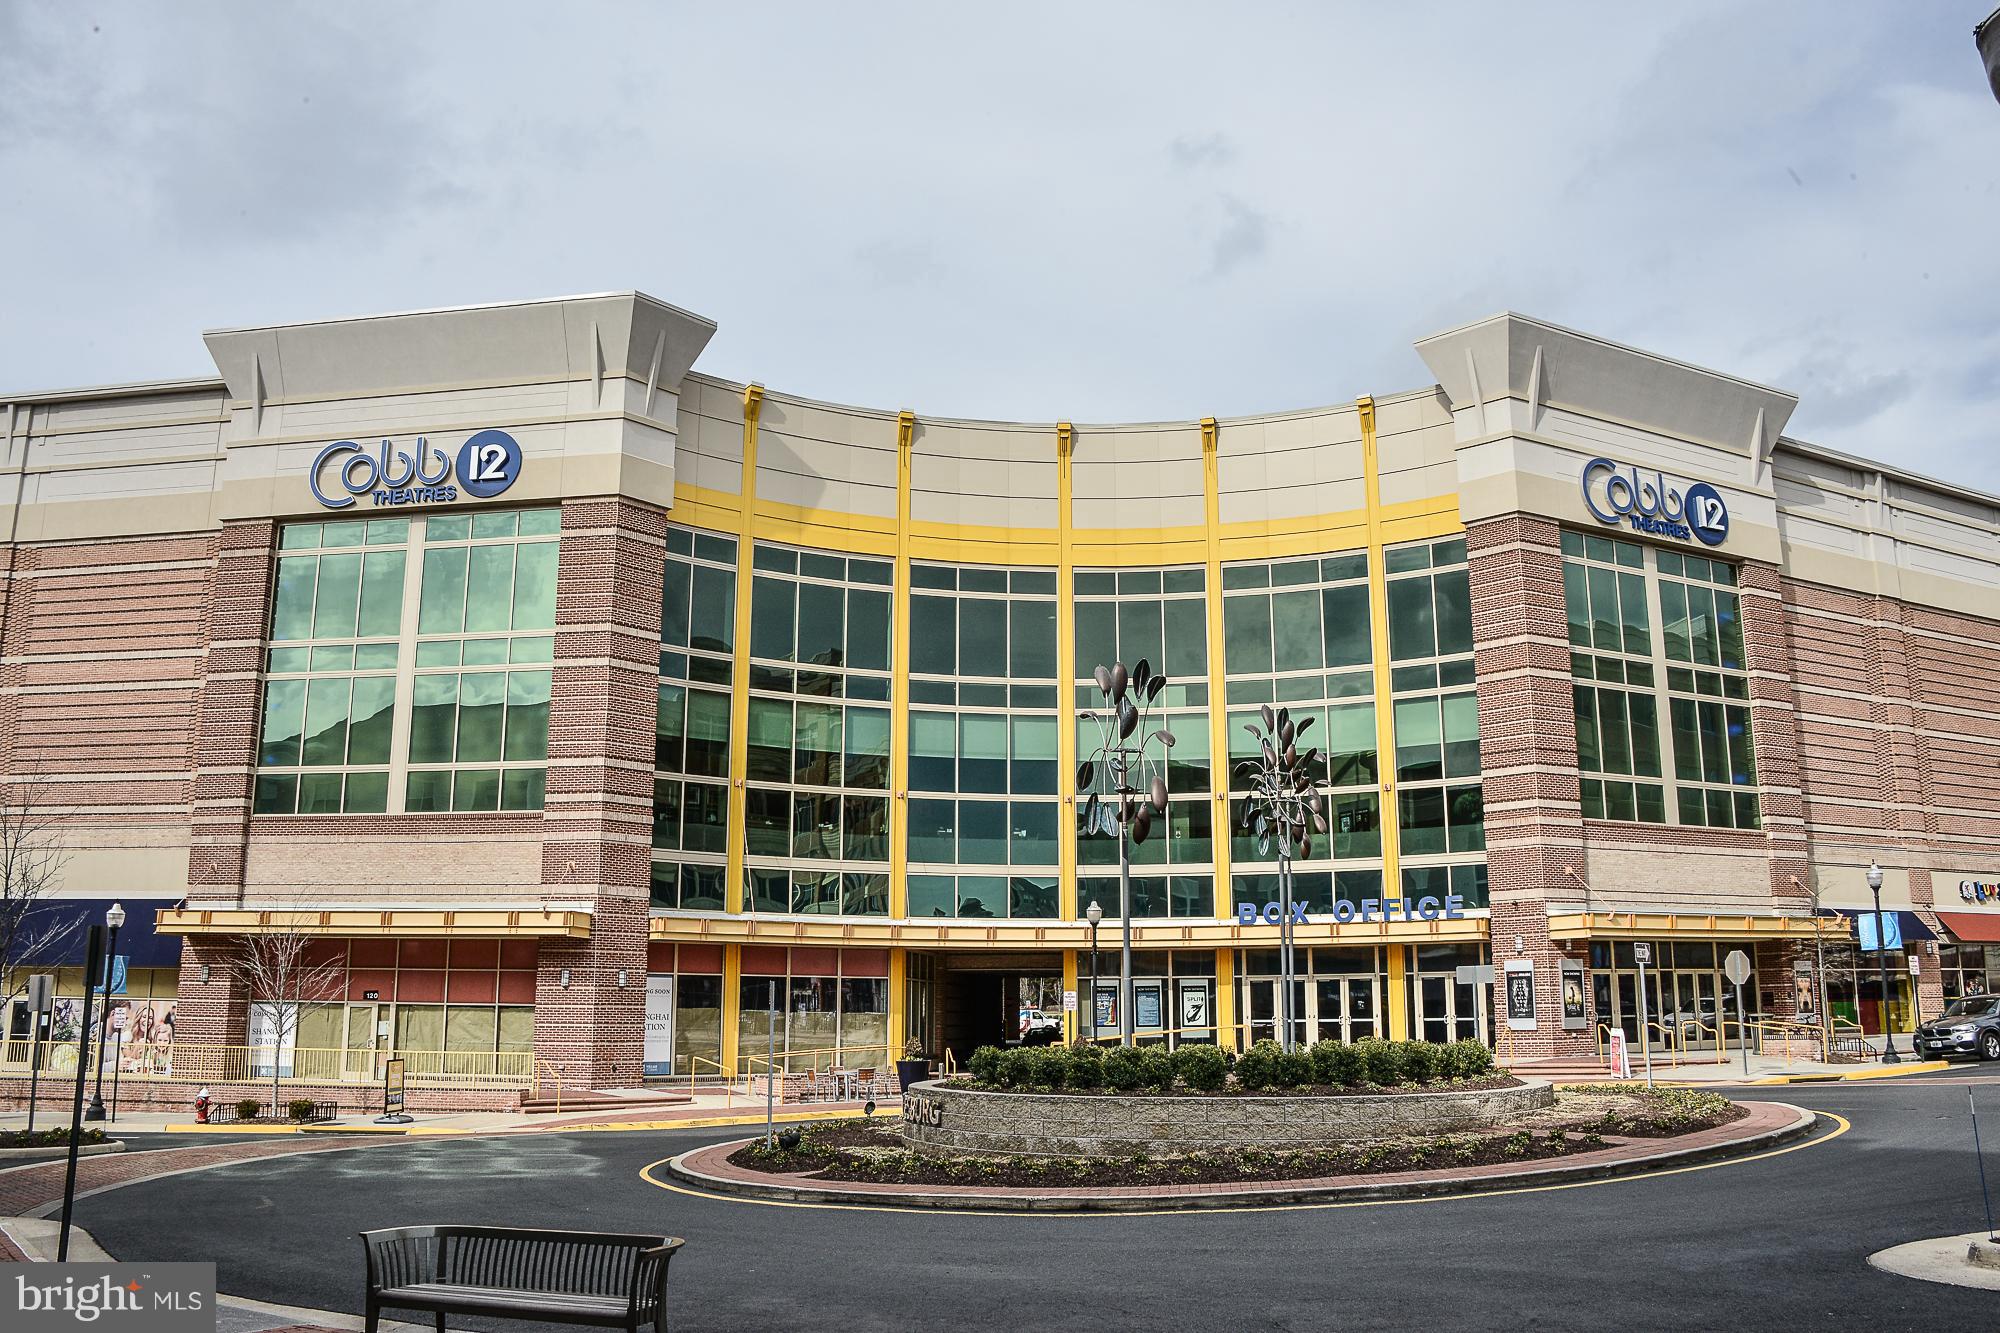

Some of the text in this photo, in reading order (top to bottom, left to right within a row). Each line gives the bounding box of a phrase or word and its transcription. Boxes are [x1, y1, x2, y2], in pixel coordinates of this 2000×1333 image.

[310, 436, 508, 507] Cobb 12
[373, 487, 457, 505] THEATRES
[1580, 457, 1726, 531] Cobb 12
[1628, 514, 1691, 540] THEATRES
[1238, 894, 1465, 925] BOX OFFICE
